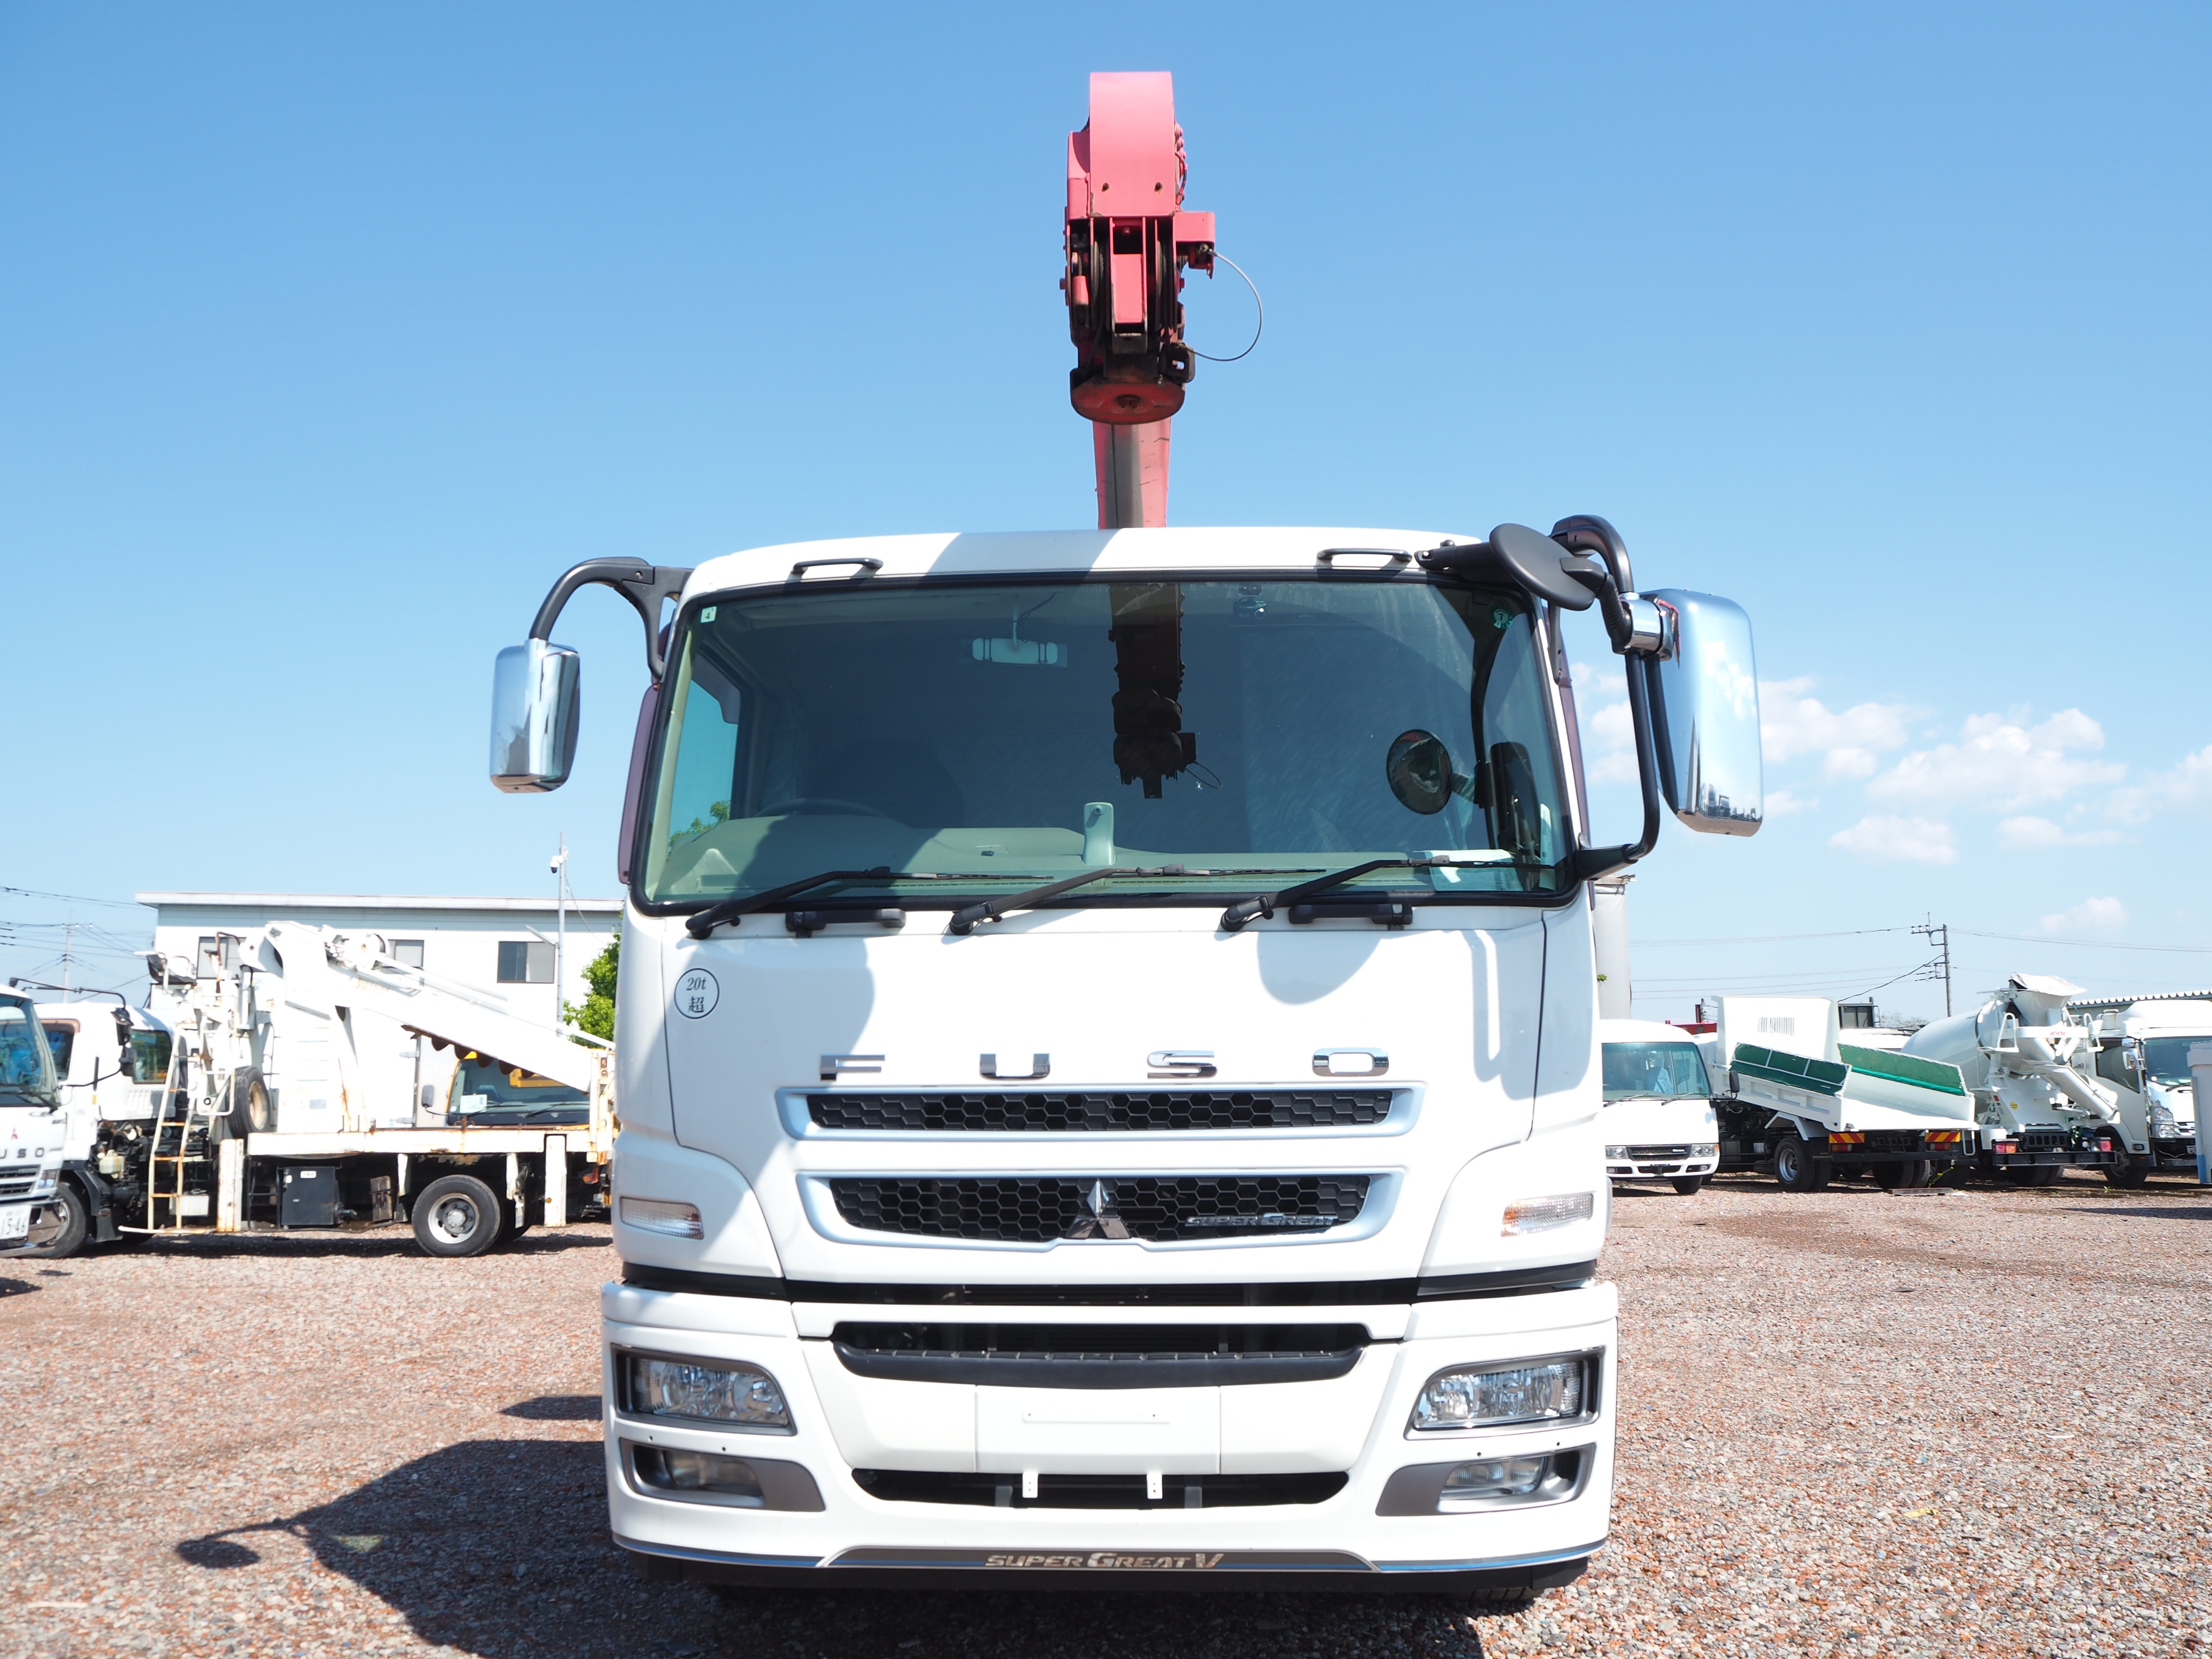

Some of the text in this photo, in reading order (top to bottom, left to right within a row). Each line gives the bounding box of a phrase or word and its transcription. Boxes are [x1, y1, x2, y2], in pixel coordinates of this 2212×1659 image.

[686, 977, 707, 991] 20t
[688, 996, 704, 1013] 超
[820, 1048, 1389, 1080] FUSO
[1185, 1213, 1338, 1227] SUPER GREAT
[986, 1552, 1224, 1568] SUPER GREAT V
